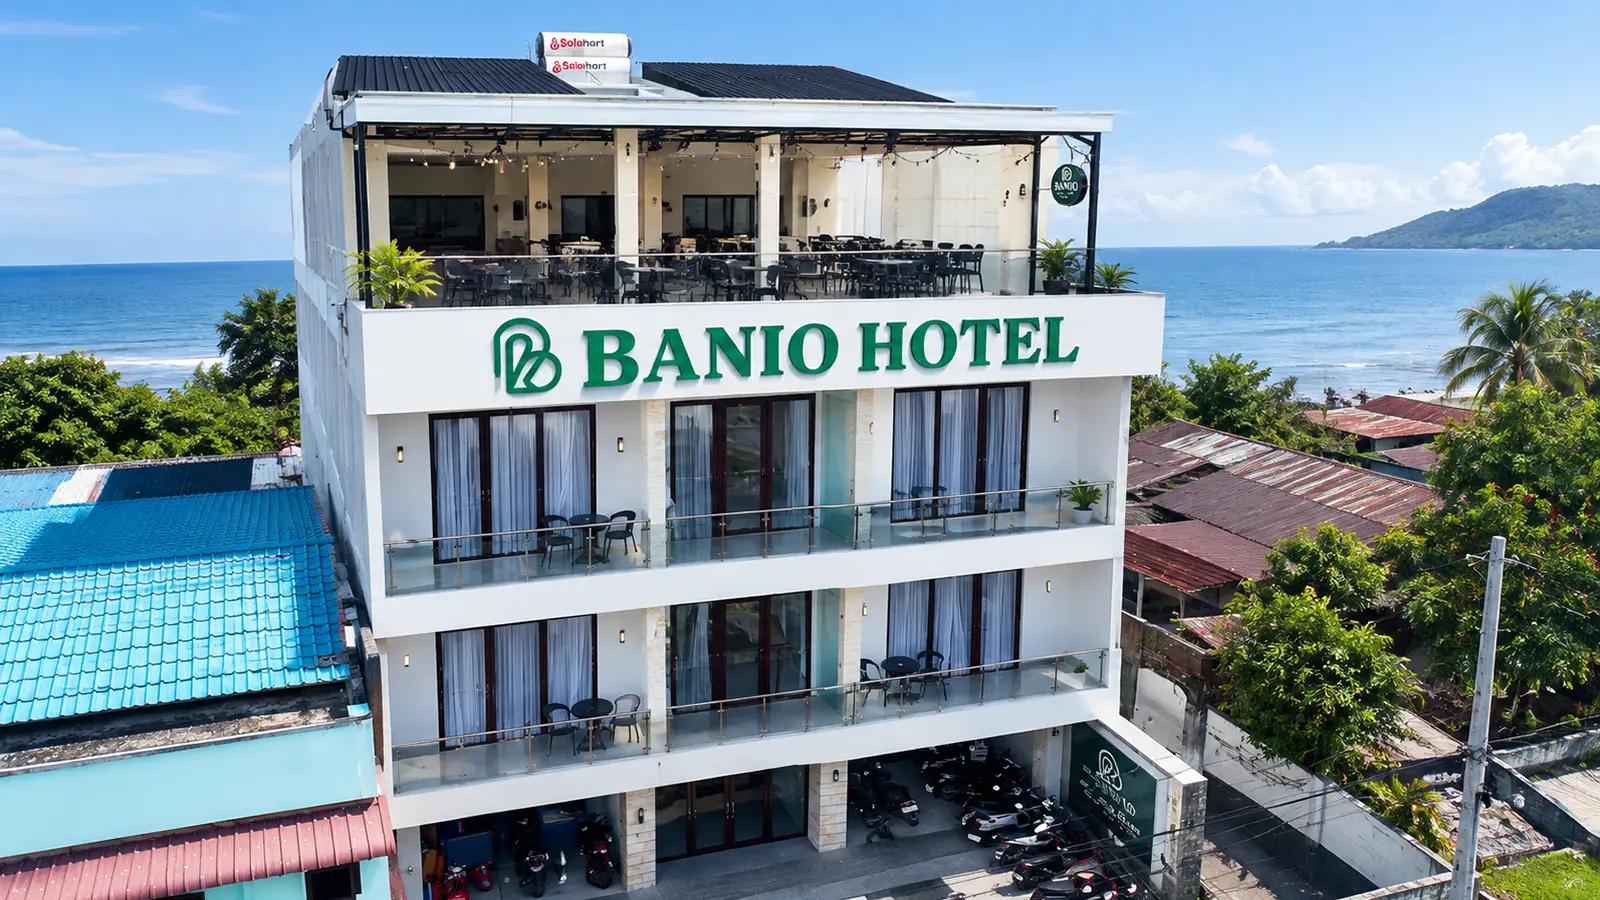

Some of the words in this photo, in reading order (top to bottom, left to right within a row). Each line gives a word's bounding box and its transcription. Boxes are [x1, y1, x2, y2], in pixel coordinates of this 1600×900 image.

[560, 38, 604, 48] Solahart
[583, 322, 839, 388] BANIO
[859, 316, 1079, 372] HOTEL
